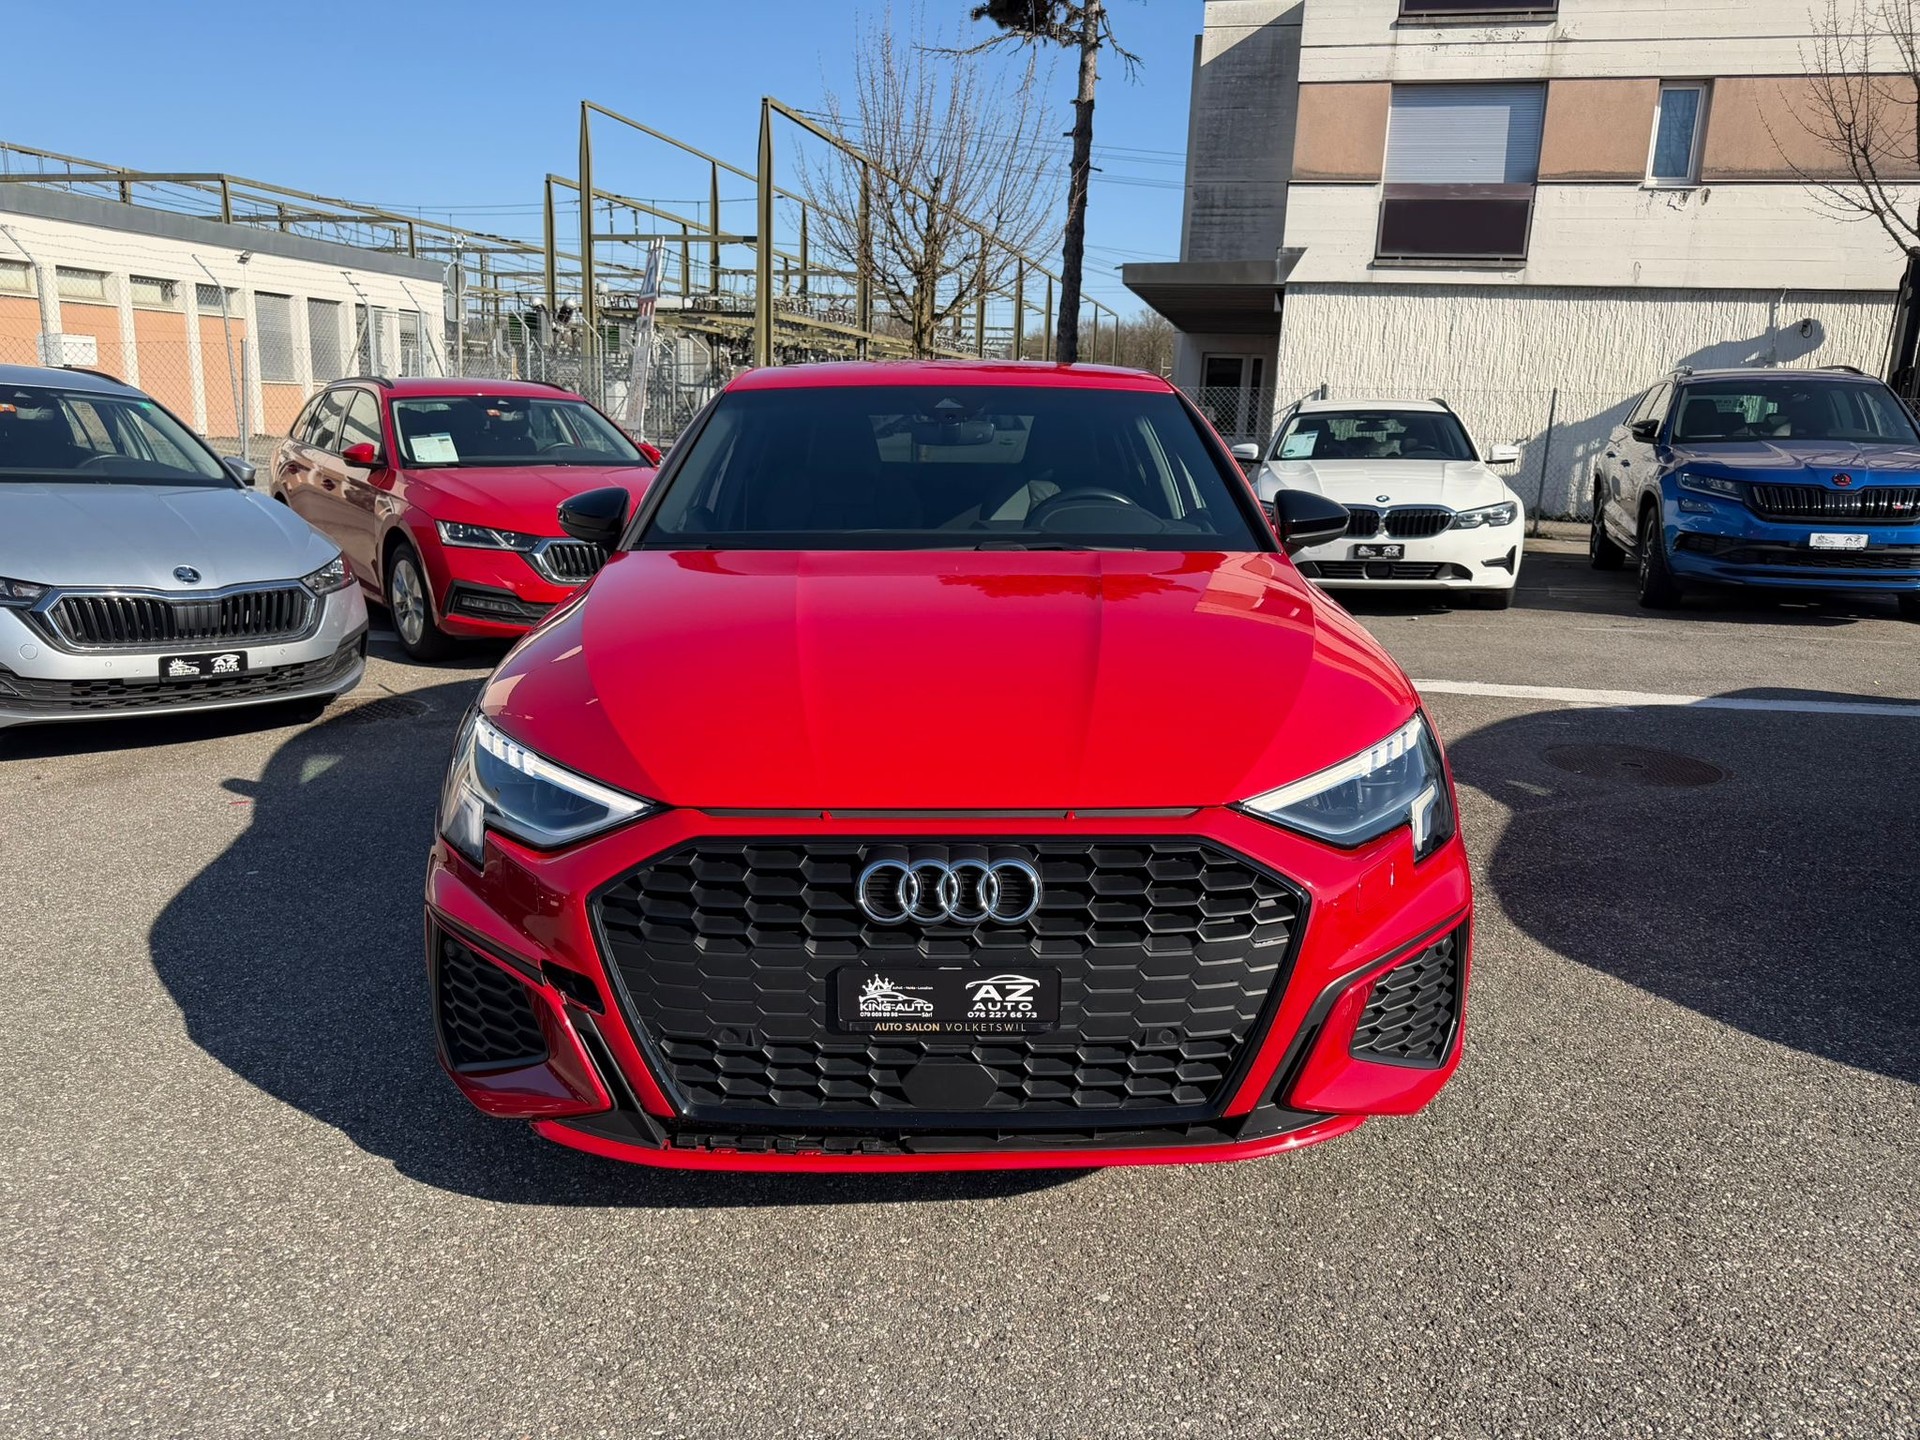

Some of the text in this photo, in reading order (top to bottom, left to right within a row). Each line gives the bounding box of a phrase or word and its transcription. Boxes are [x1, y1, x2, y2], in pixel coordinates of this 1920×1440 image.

[214, 658, 238, 666] AZ
[972, 984, 1034, 1001] AZ
[972, 1002, 1032, 1011] AUTO
[874, 1022, 1027, 1031] AUTO SALON VOLKETSWIL
